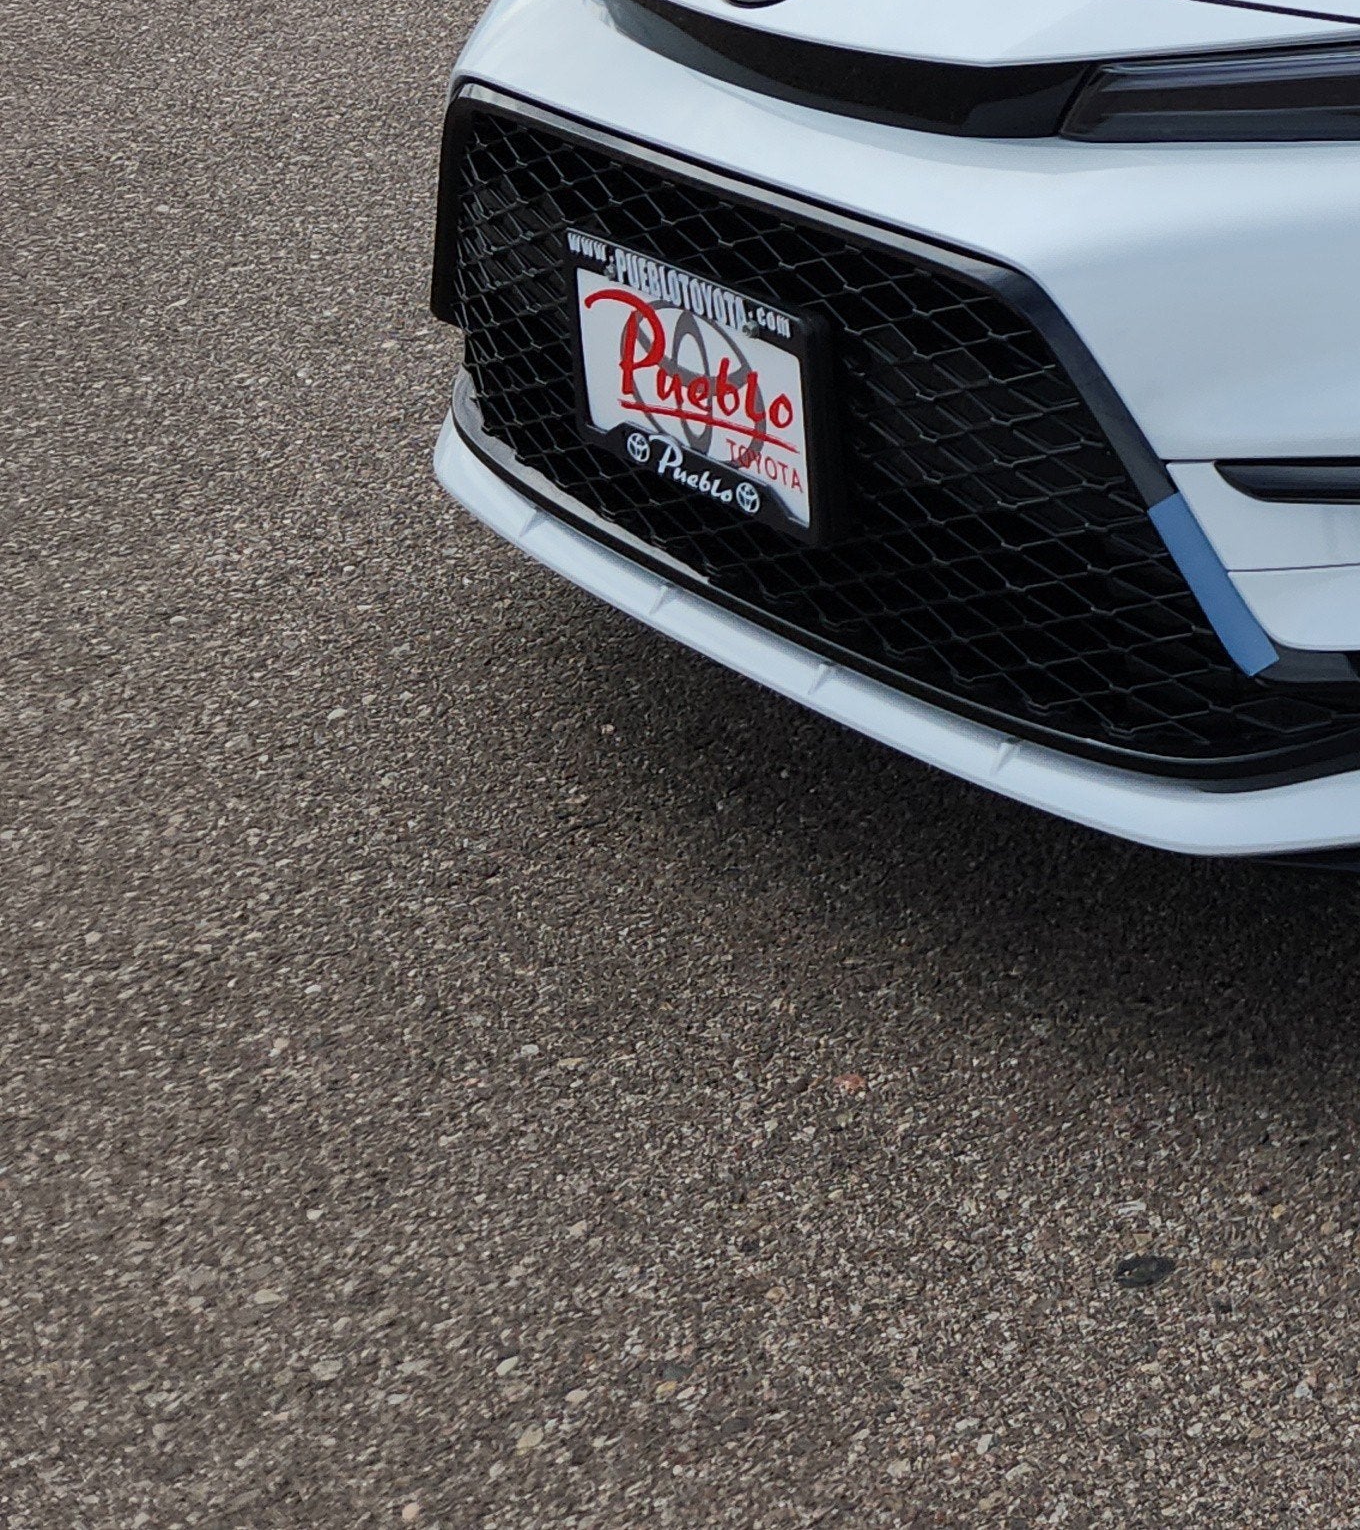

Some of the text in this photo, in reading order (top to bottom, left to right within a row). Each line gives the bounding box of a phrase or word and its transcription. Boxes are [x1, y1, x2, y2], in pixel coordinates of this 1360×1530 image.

[584, 288, 793, 429] Pueblo
[649, 434, 733, 503] Pueblo
[726, 438, 804, 494] TOYOTA
